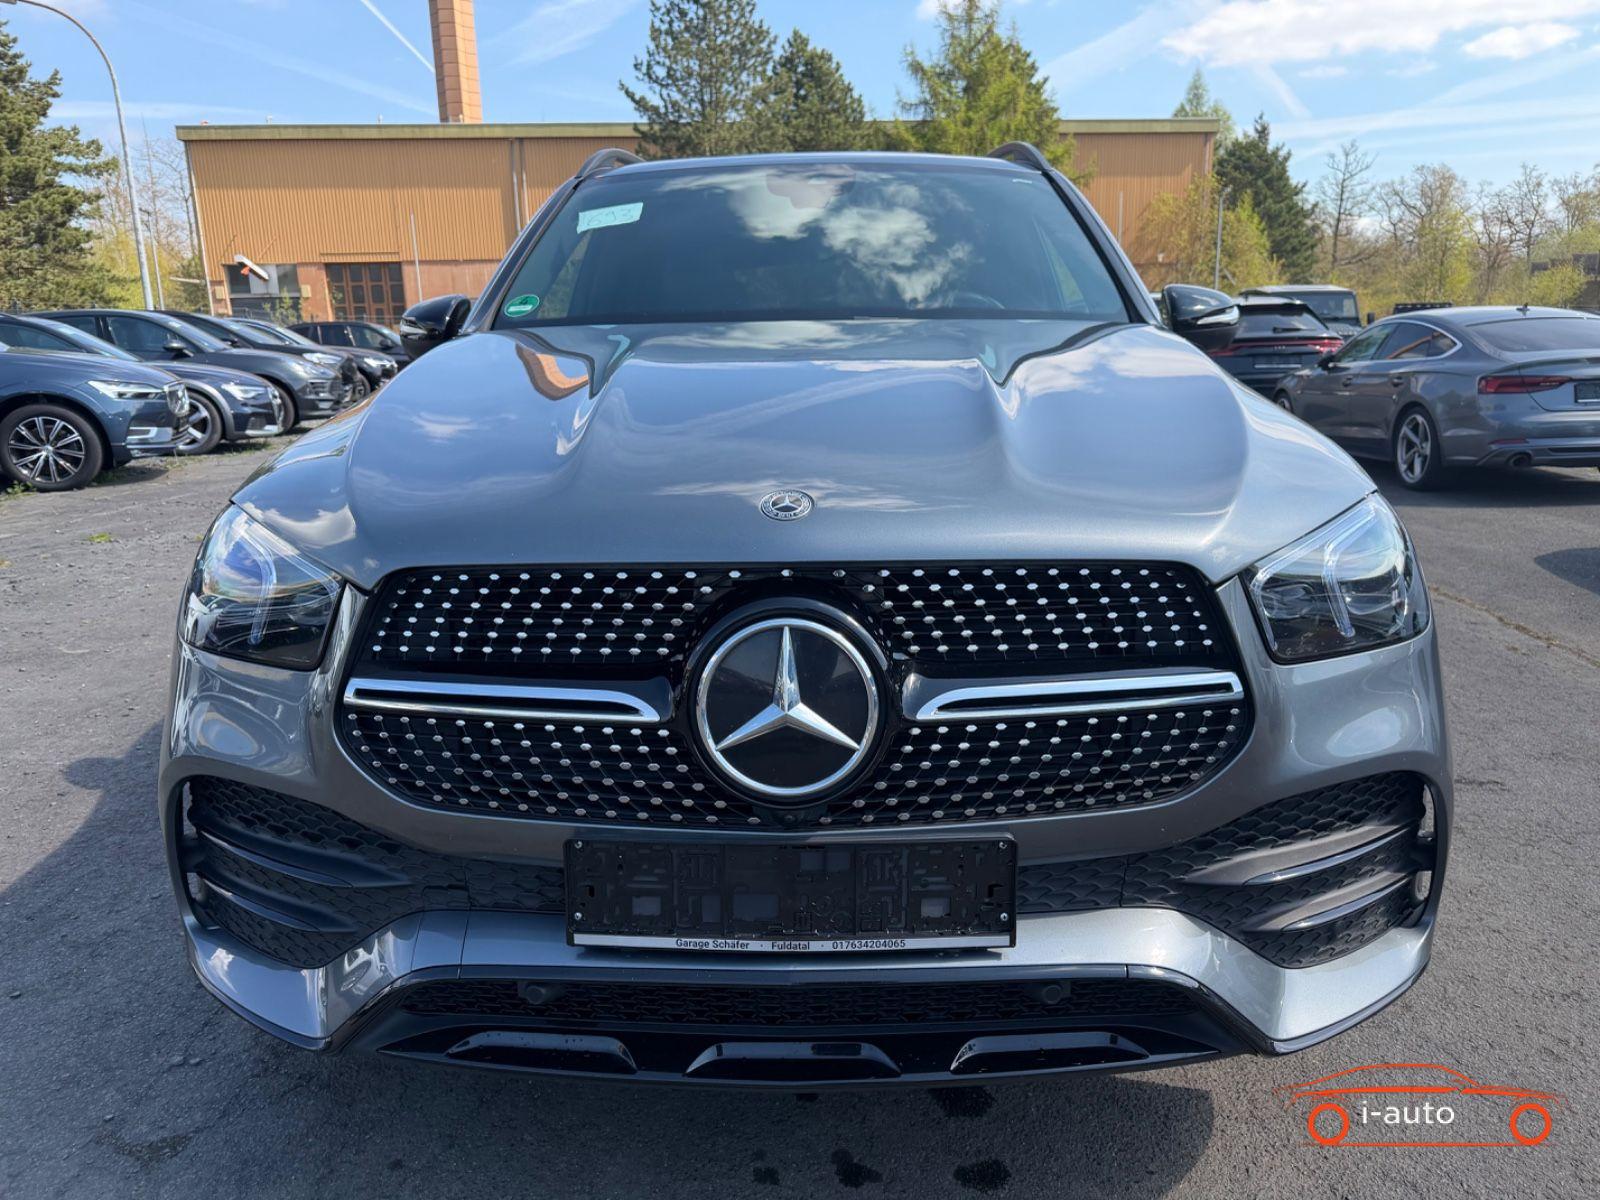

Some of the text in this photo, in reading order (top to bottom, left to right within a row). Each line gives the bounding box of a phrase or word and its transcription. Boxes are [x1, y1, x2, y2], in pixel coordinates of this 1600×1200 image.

[675, 938, 710, 950] Garage
[771, 941, 810, 951] Fuldatal
[831, 939, 906, 950] 017634204065
